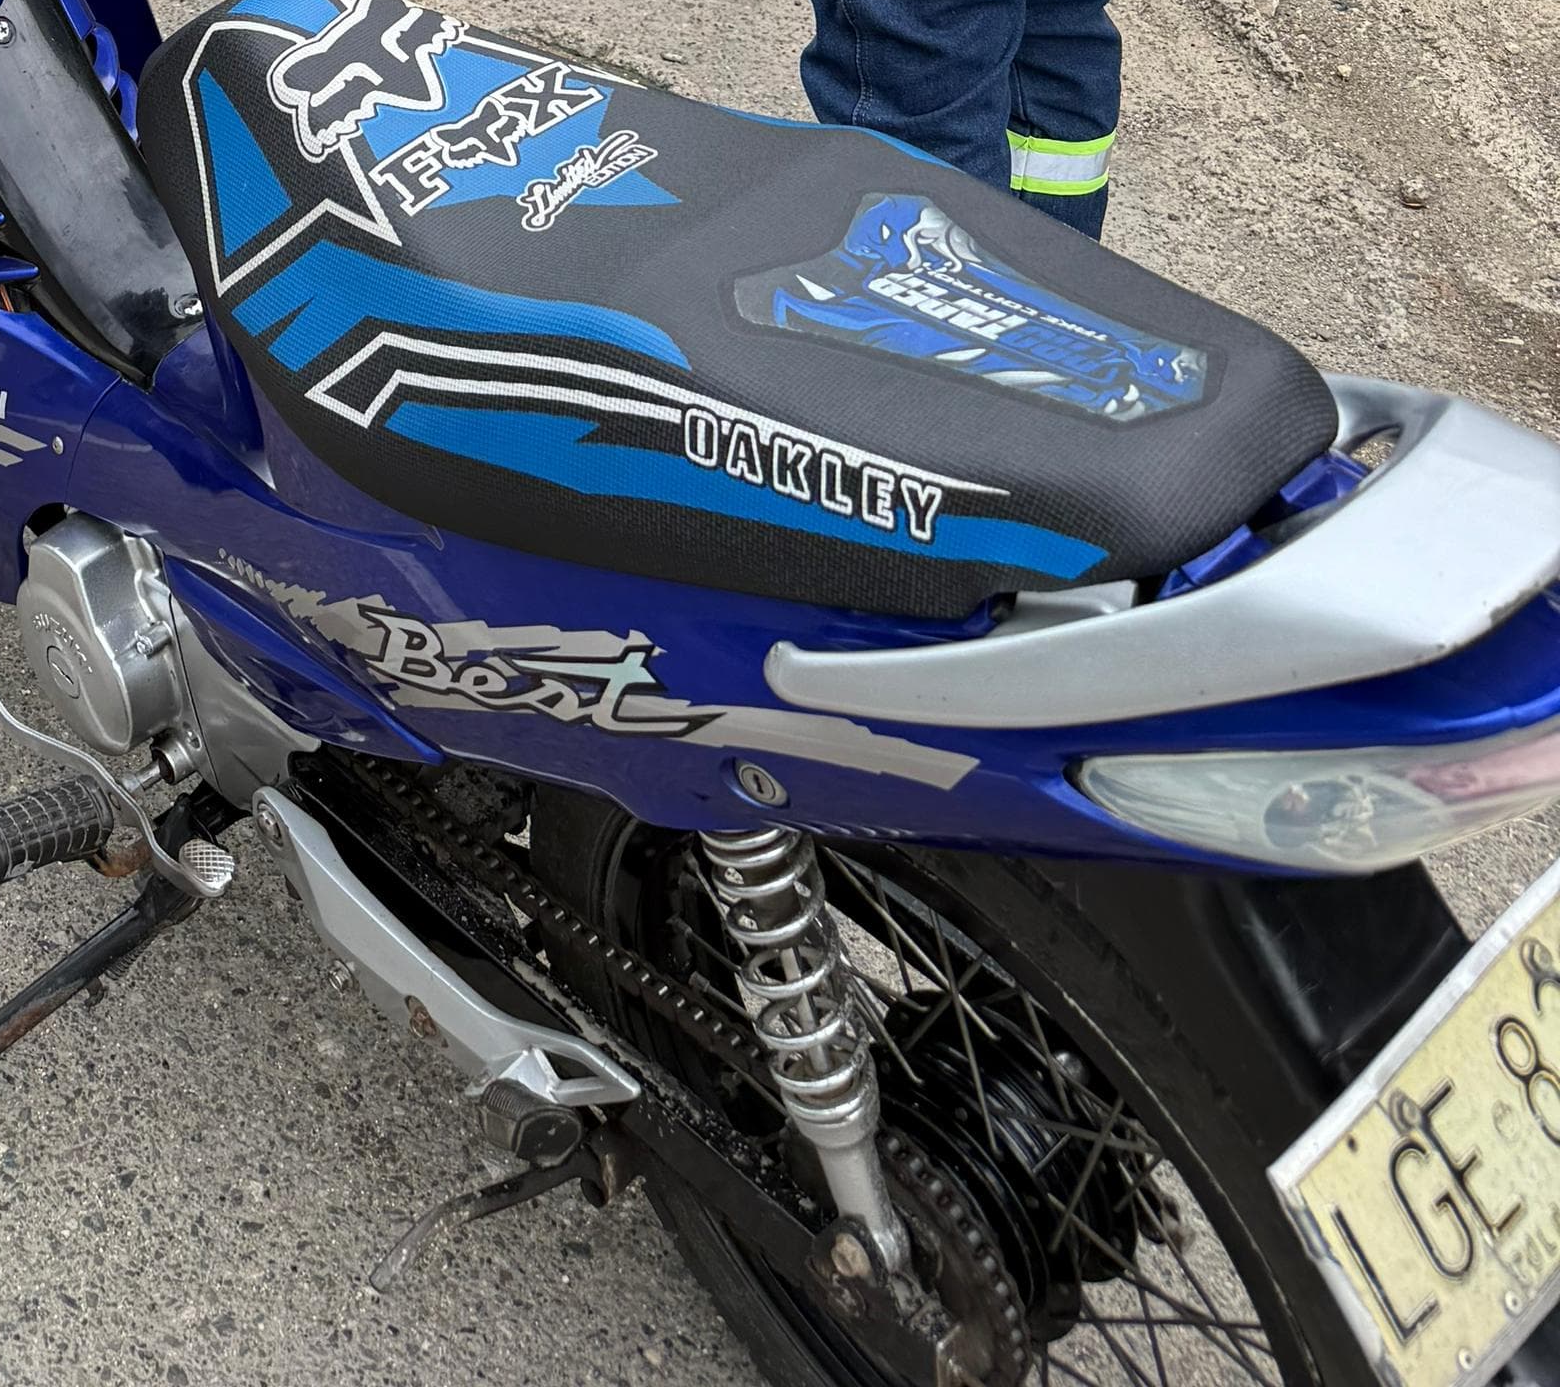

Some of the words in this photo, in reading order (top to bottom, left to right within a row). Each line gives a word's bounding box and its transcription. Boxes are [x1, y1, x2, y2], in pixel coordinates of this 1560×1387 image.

[683, 406, 943, 542] OAKLEY
[357, 603, 727, 738] Best
[1328, 1077, 1526, 1347] LGE
